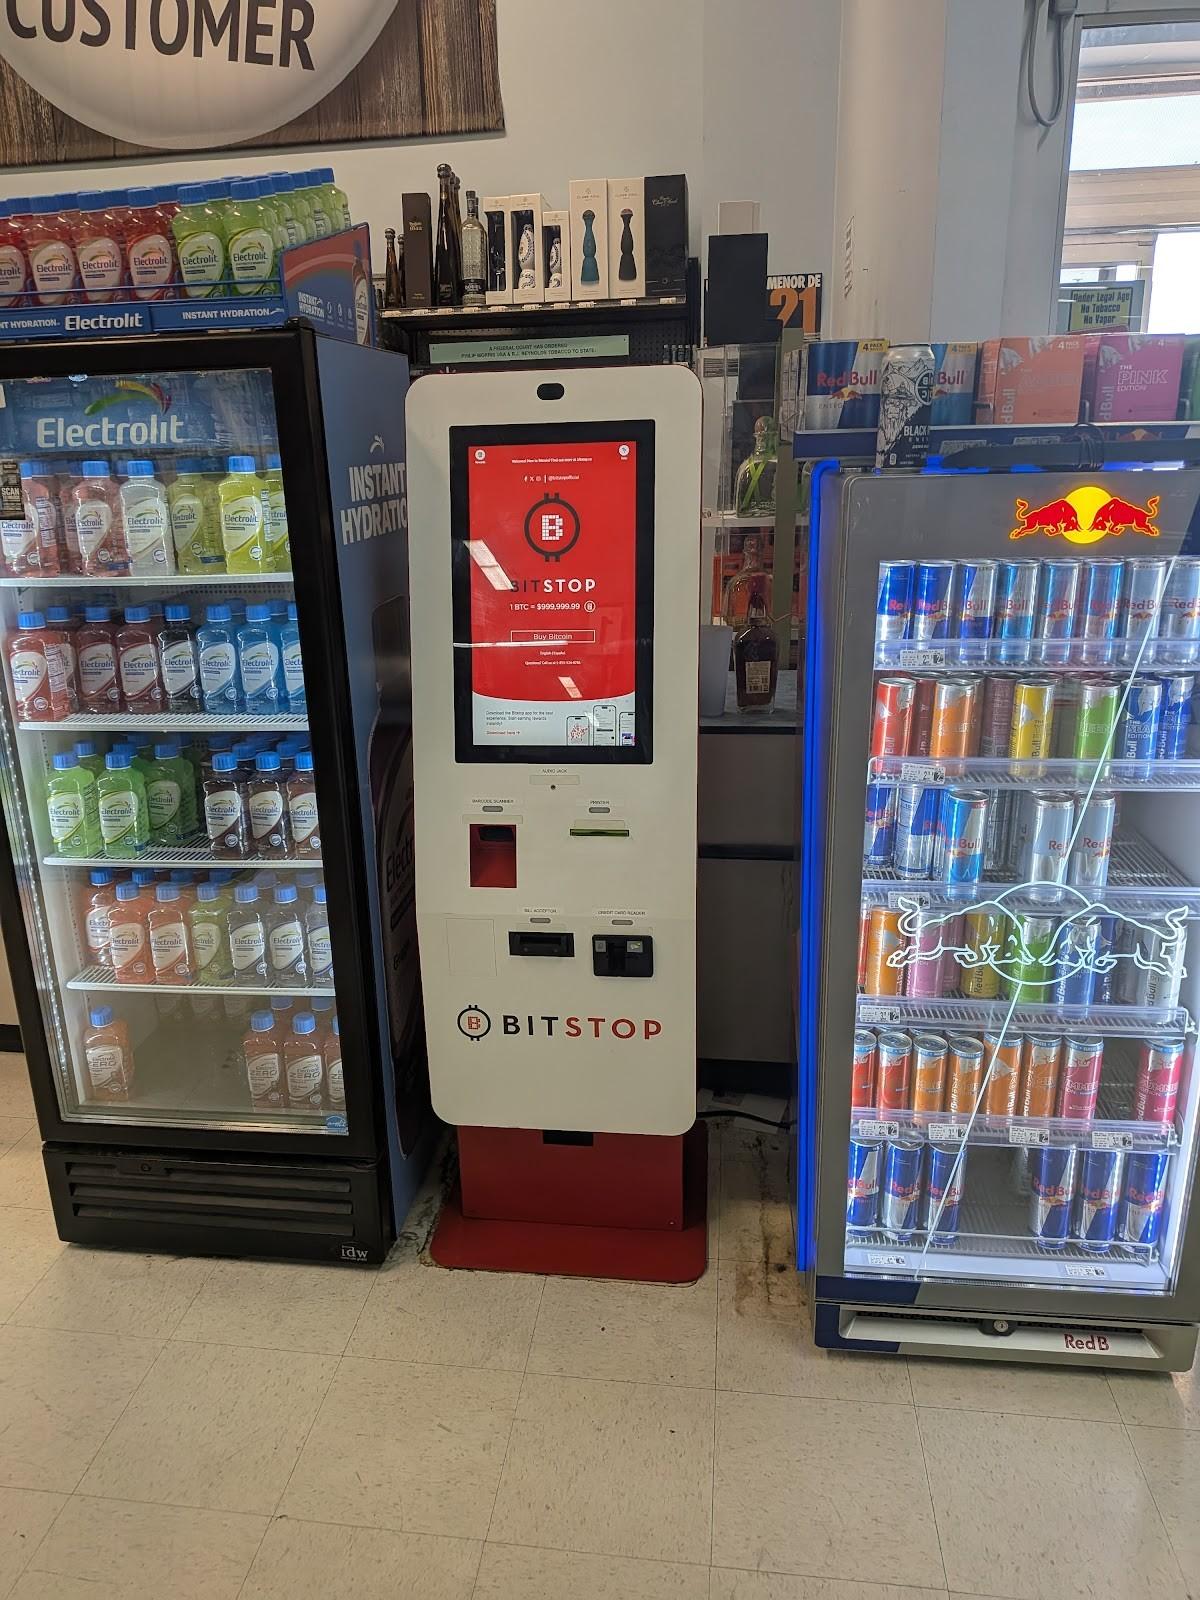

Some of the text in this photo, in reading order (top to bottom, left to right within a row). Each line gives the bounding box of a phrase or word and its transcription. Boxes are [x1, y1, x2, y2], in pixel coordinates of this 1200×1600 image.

[7, 0, 315, 71] CUSTOMER
[134, 256, 168, 266] Electrolit
[182, 254, 218, 265] Electrolit
[234, 252, 268, 262] Electrolit
[36, 264, 72, 272] Electrolit
[82, 260, 119, 270] Electrolit
[0, 266, 20, 276] trolit
[767, 274, 822, 290] MENOR DE
[1096, 292, 1114, 303] Legal
[1117, 292, 1130, 302] Age
[182, 308, 270, 320] INSTANT HYDRATION
[1080, 304, 1120, 314] No Tobacco
[11, 319, 57, 328] HYDRATION
[64, 312, 144, 331] Electrolit
[1084, 315, 1116, 325] No Vapor
[1058, 341, 1064, 350] 4
[816, 370, 877, 387] Red Bull
[938, 370, 964, 385] Bull
[1118, 370, 1169, 384] PINK
[1002, 388, 1016, 414] Bull
[1100, 386, 1114, 410] Bull
[36, 414, 184, 448] Electrolit
[349, 462, 406, 502] INSTANT
[1, 488, 20, 496] SCAN
[128, 518, 164, 526] Electrolit
[340, 497, 408, 546] HYDRATIO
[537, 603, 580, 611] $999,999.99
[1123, 599, 1145, 610] Red
[1174, 598, 1194, 609] Red
[1127, 740, 1137, 758] Bull
[502, 1014, 662, 1040] BITSTOP
